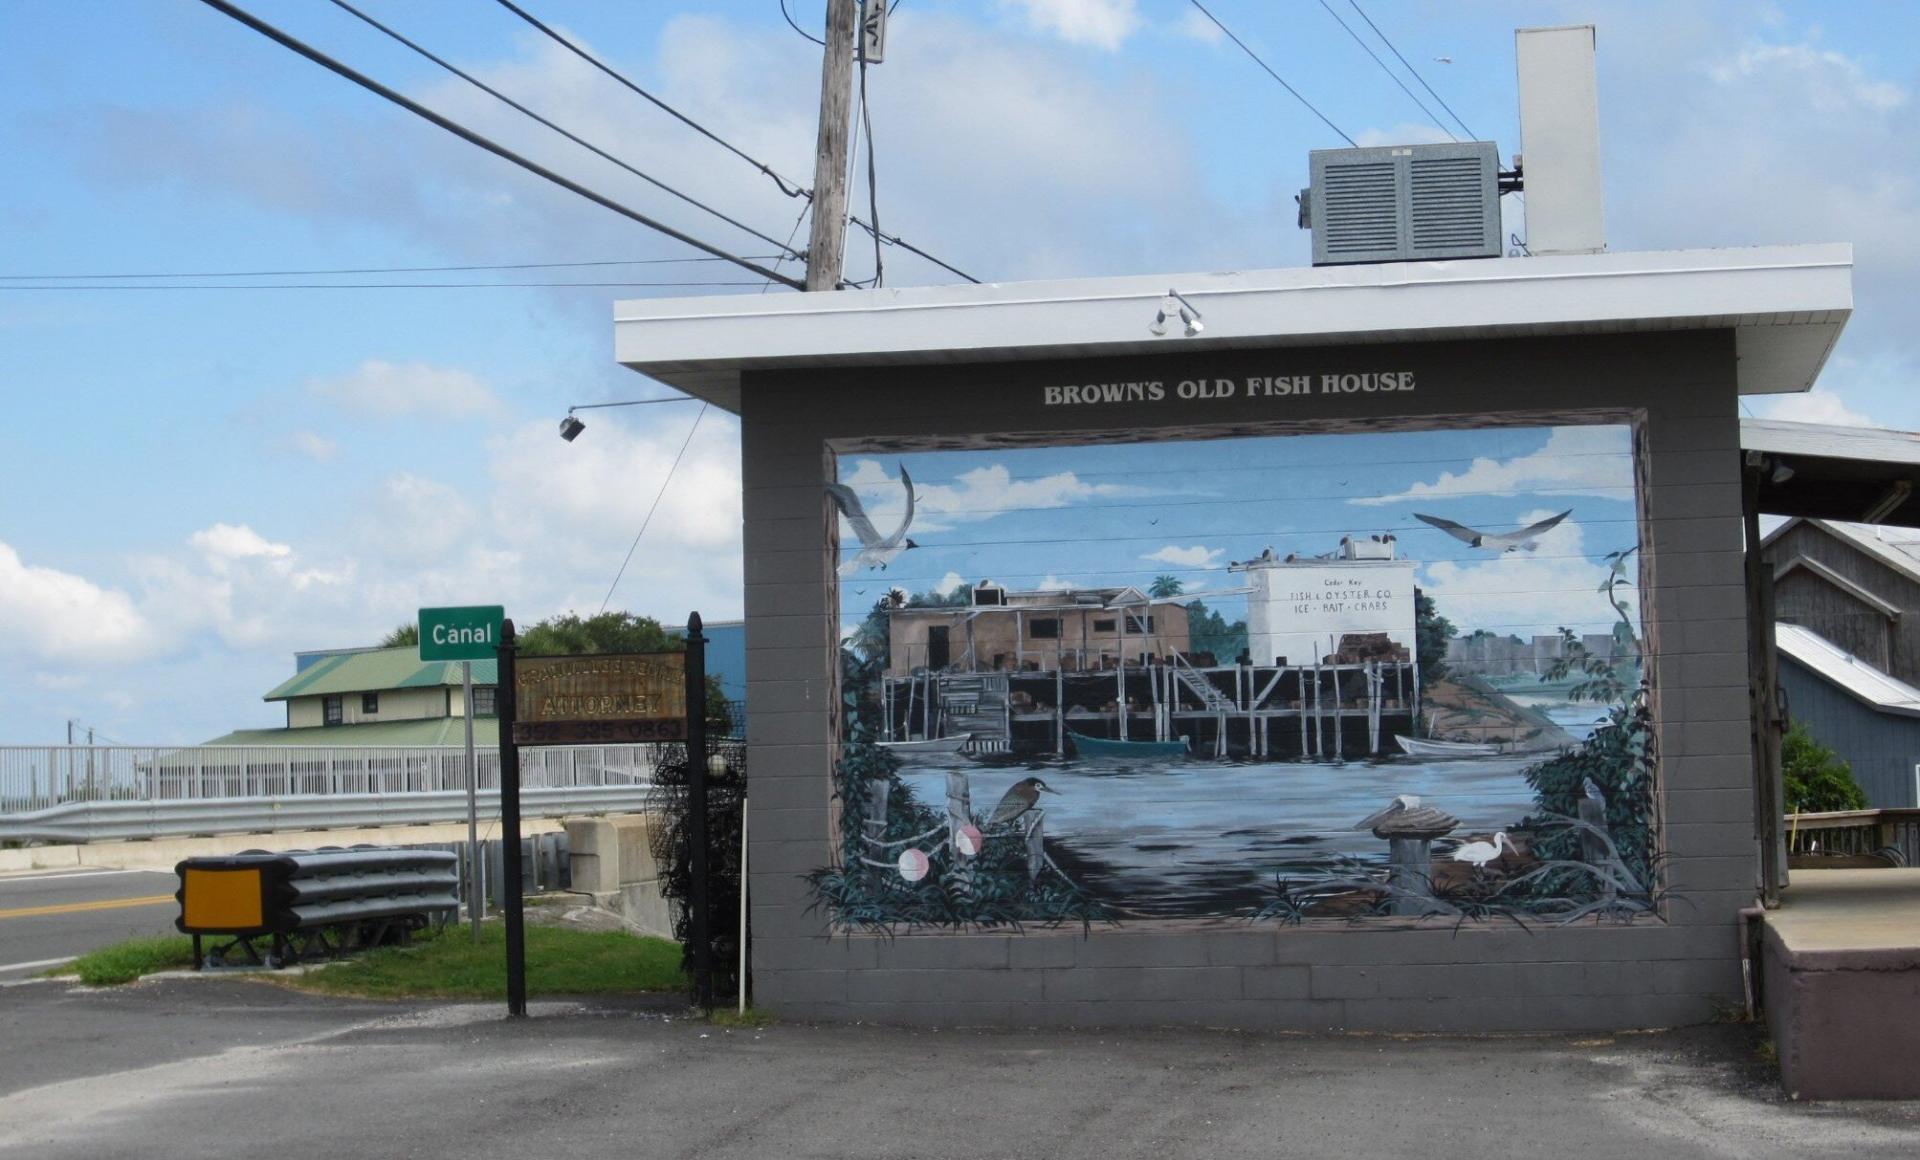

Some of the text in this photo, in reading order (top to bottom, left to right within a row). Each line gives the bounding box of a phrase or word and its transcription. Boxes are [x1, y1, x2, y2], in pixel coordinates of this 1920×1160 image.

[1044, 371, 1416, 405] BROWN'S OLD FISH HOUSE
[1325, 590, 1370, 600] OYSTER
[1295, 601, 1388, 614] ICE BAIT CRABS
[432, 623, 493, 645] Canal
[542, 693, 661, 715] ATTORNEY
